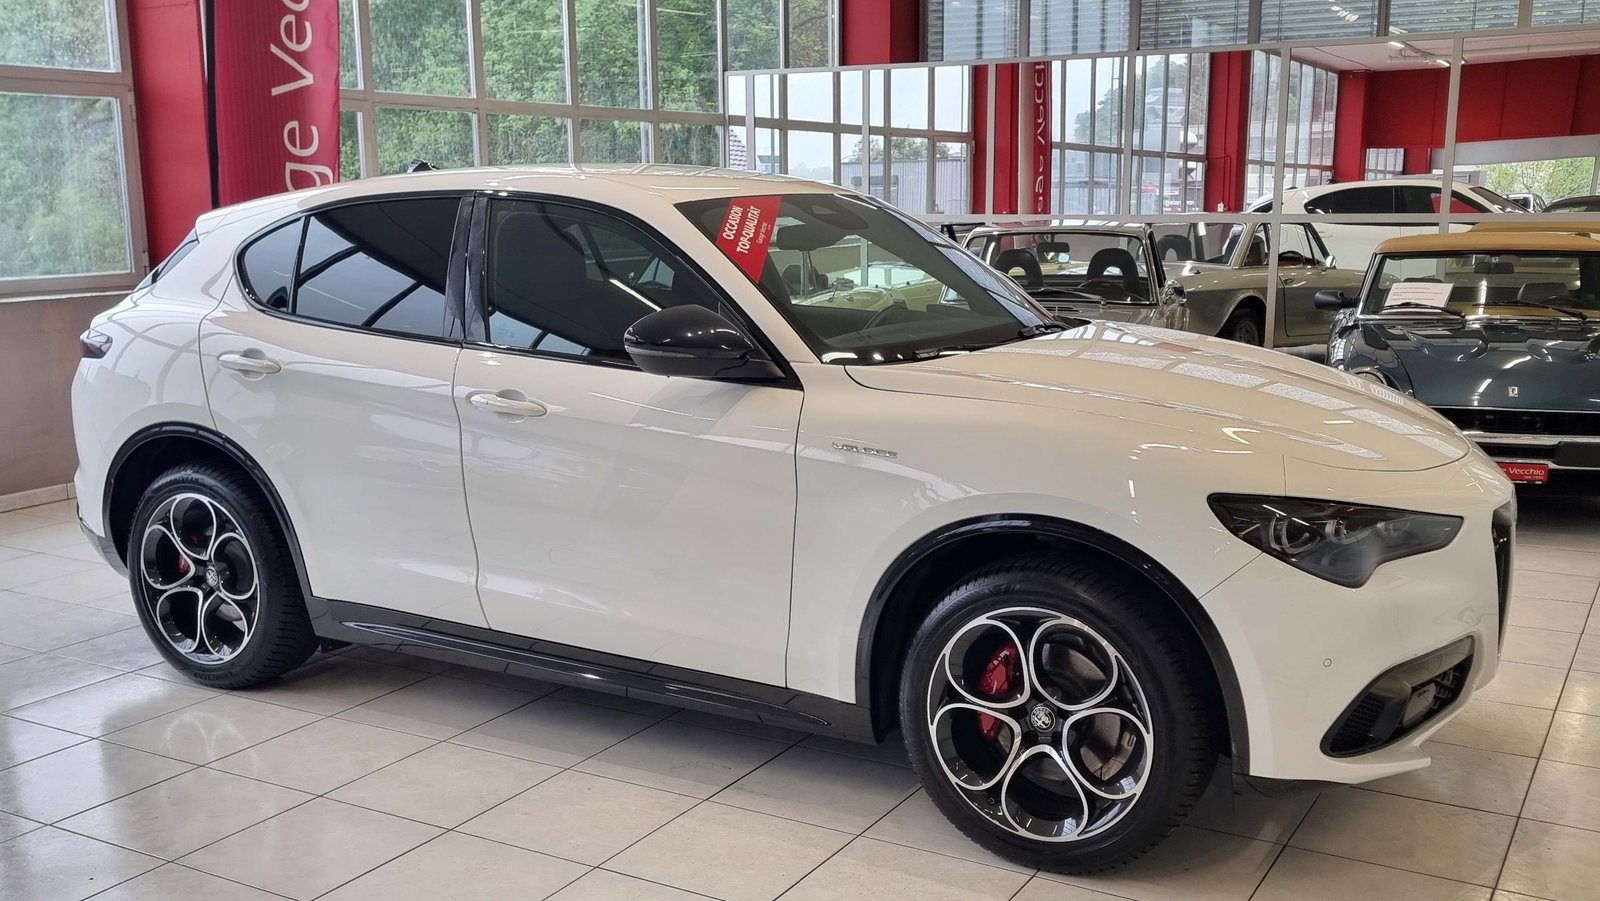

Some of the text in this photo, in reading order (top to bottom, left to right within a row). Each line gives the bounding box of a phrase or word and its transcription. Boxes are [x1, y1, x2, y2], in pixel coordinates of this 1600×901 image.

[722, 204, 744, 240] OCCASION
[736, 205, 761, 254] TOP-QUALITÄT
[1508, 467, 1545, 476] Vecchio
